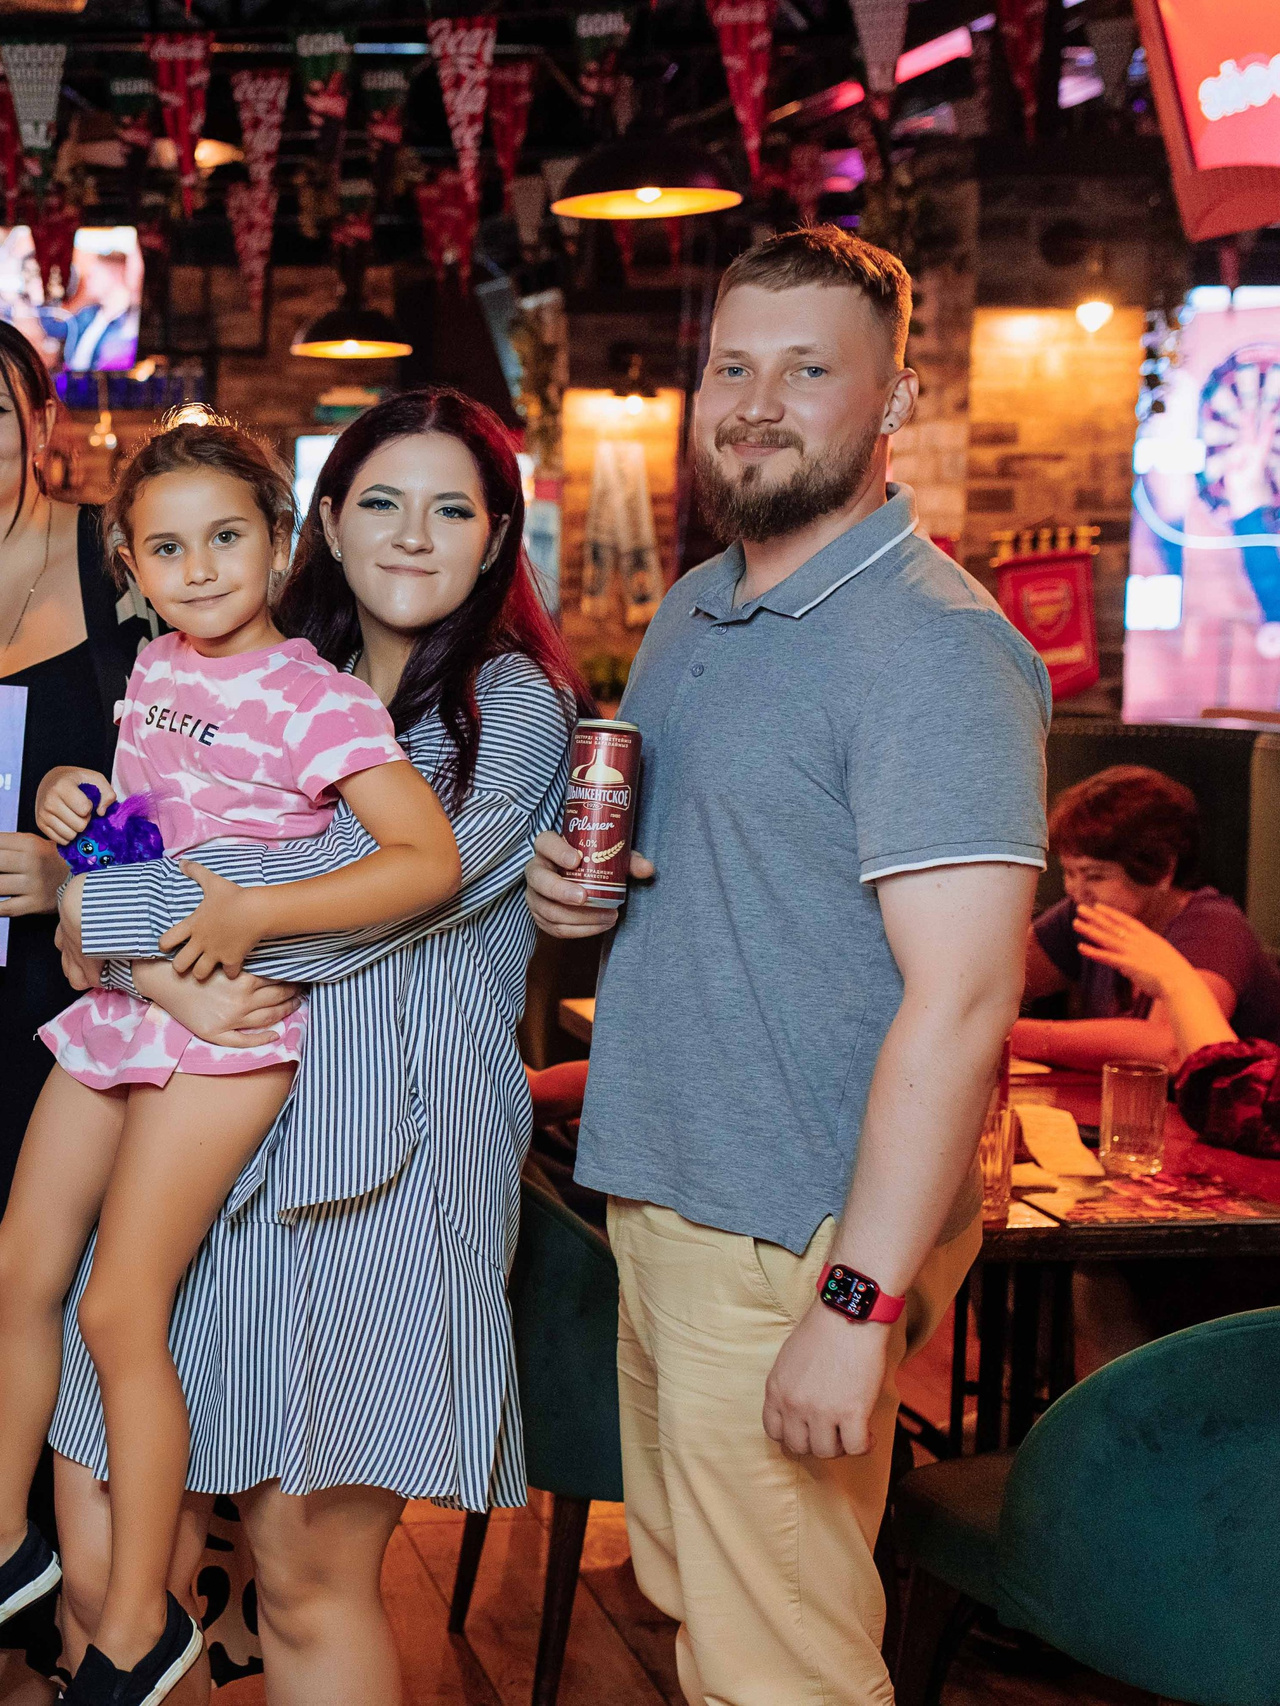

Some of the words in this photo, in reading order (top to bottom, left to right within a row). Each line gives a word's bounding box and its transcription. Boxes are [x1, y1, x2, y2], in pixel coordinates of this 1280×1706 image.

[145, 705, 219, 747] SELFIE
[568, 815, 615, 833] Pilsner
[578, 838, 598, 848] 4,0%
